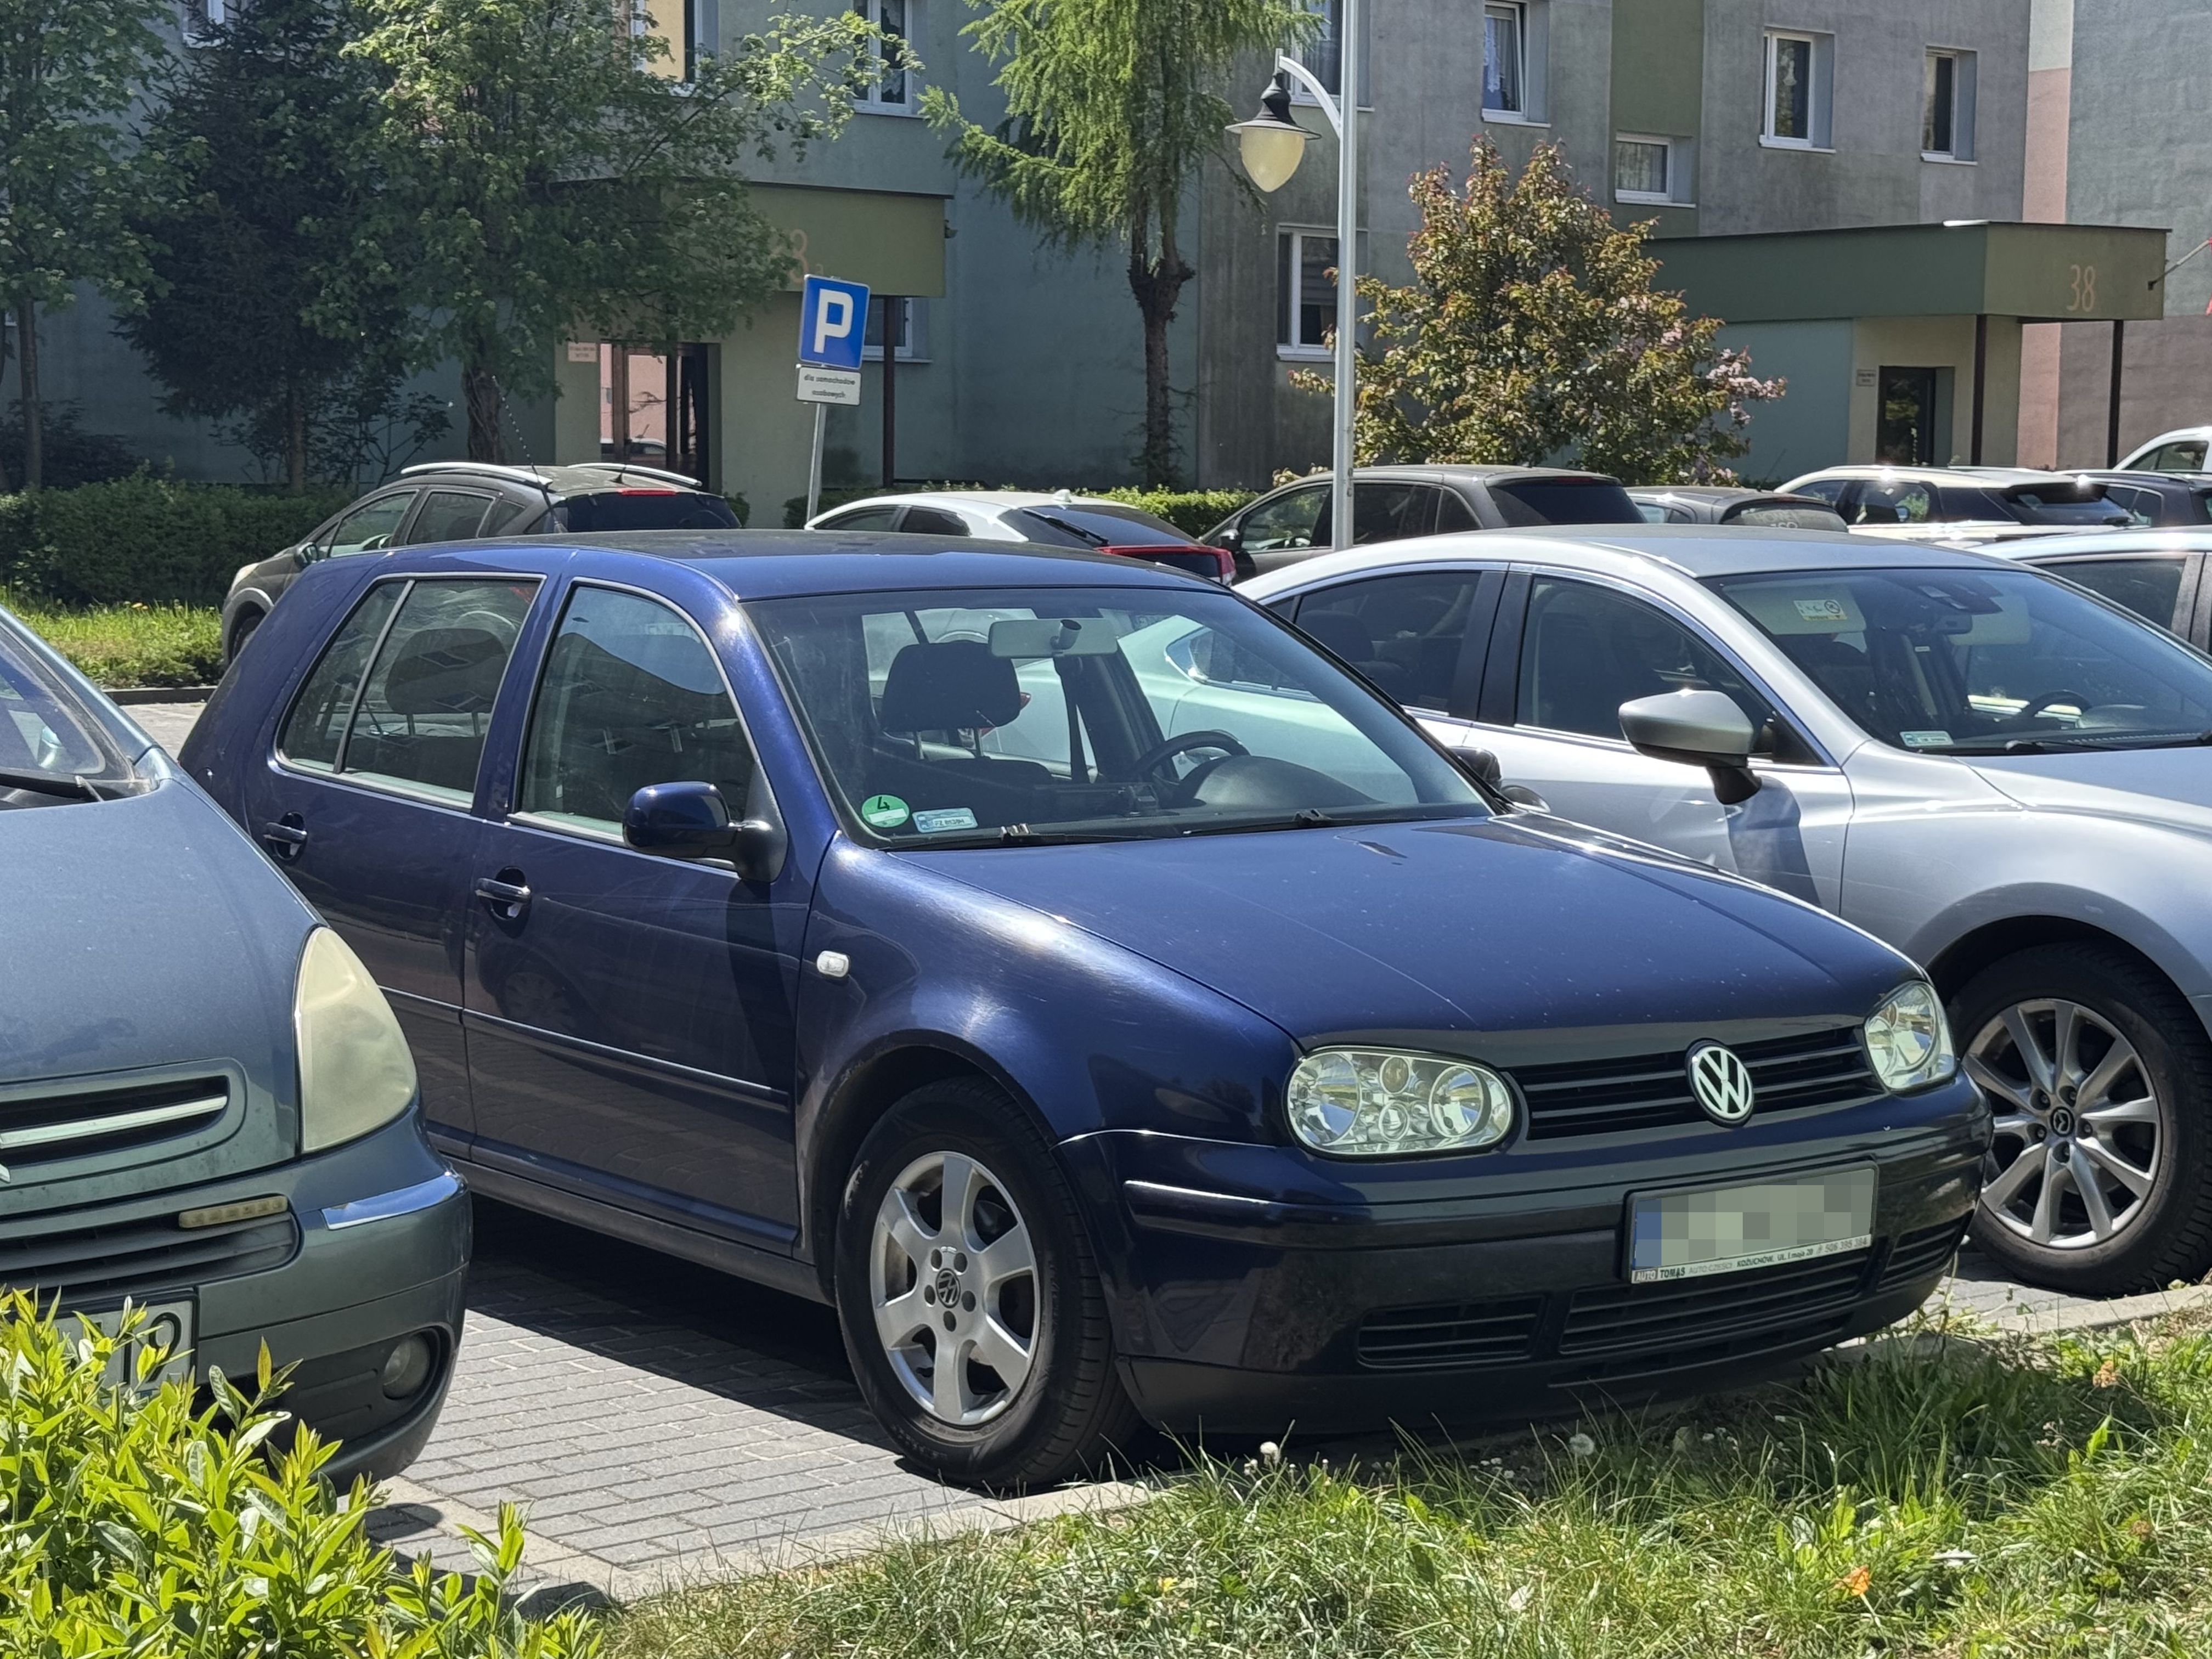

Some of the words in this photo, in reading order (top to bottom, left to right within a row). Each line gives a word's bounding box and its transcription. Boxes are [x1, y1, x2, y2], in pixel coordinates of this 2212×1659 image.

[2066, 264, 2096, 312] 38
[814, 288, 854, 354] P
[877, 796, 890, 810] 4
[1692, 1046, 1753, 1120] VW
[1635, 1270, 1657, 1282] AUTO
